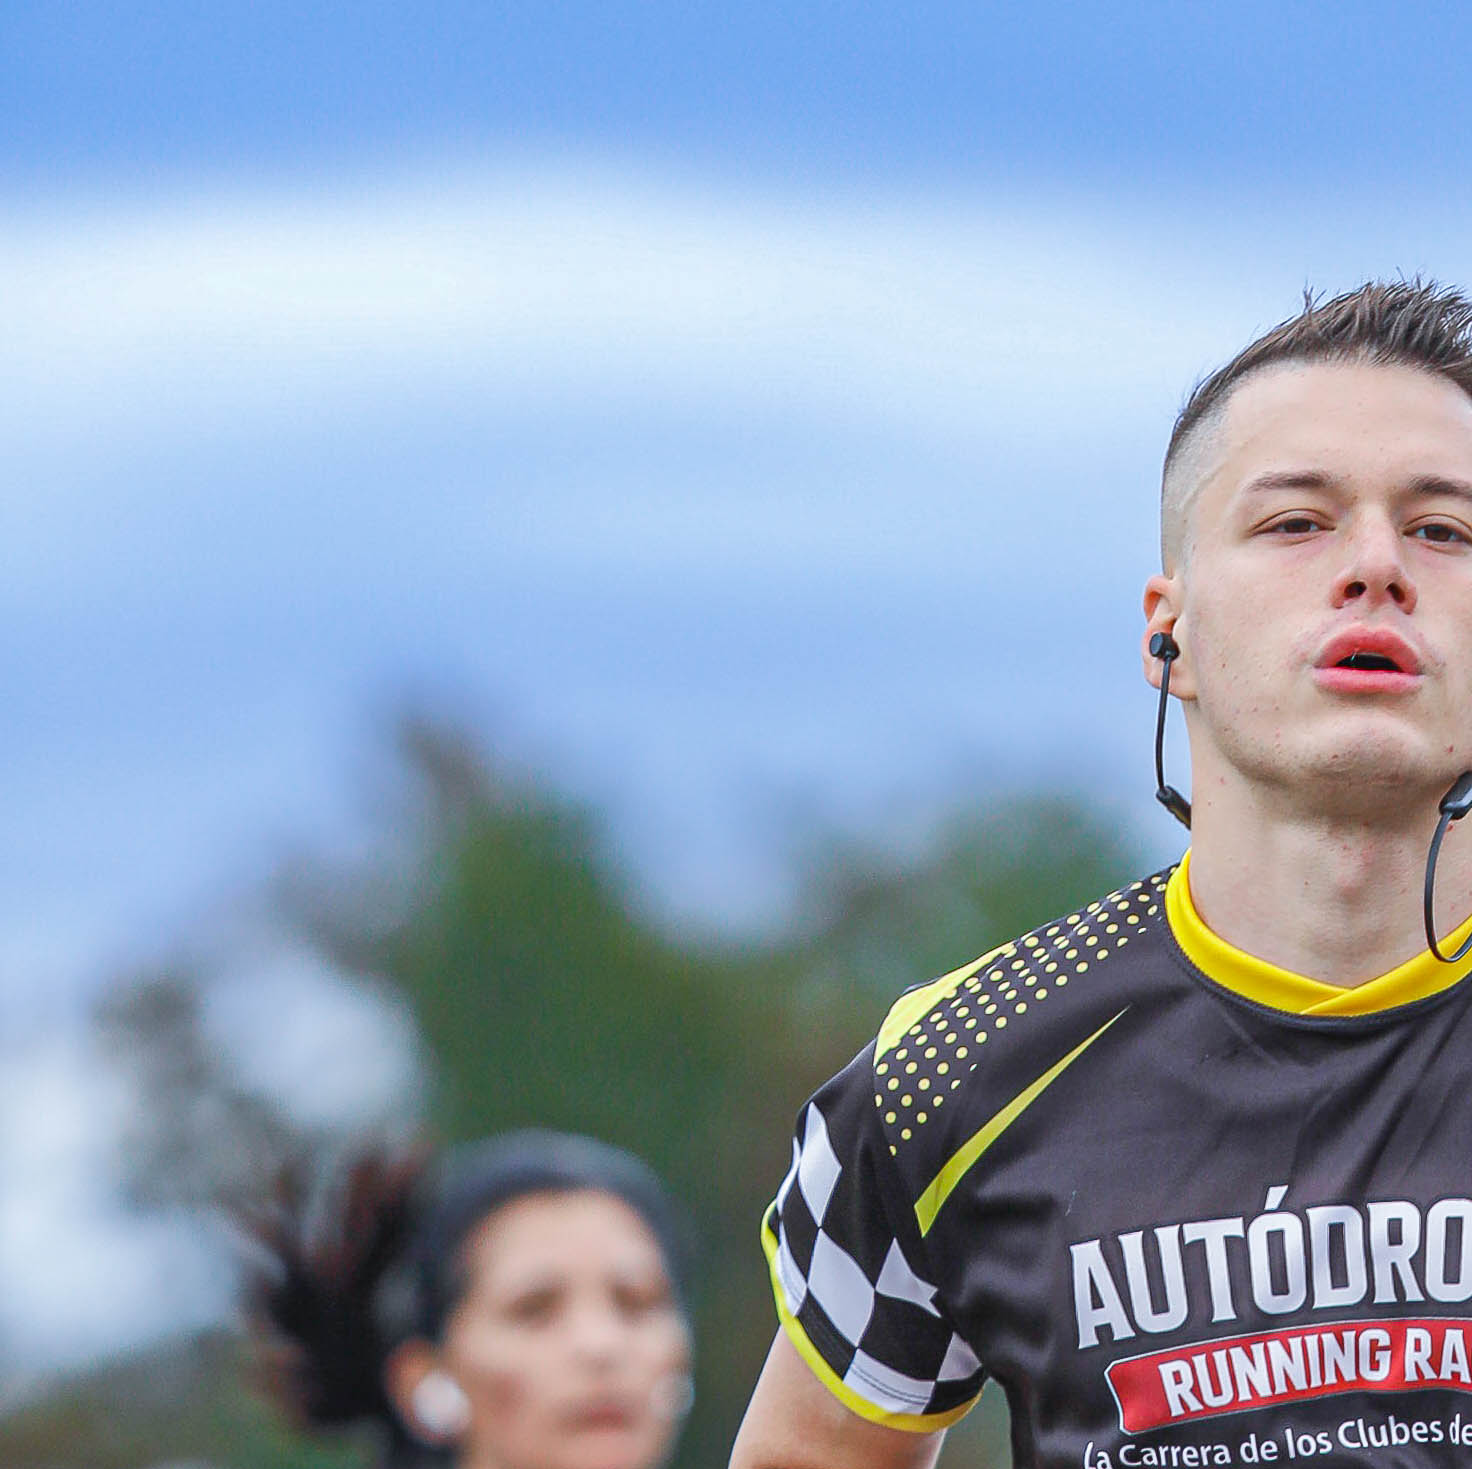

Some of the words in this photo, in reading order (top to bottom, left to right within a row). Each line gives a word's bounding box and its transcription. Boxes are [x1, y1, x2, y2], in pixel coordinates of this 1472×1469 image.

[1157, 1327, 1393, 1418] RUNNING
[1119, 1443, 1232, 1467] Carrera
[1240, 1433, 1278, 1463] de
[1285, 1427, 1333, 1459] los
[1337, 1414, 1445, 1449] Clubes
